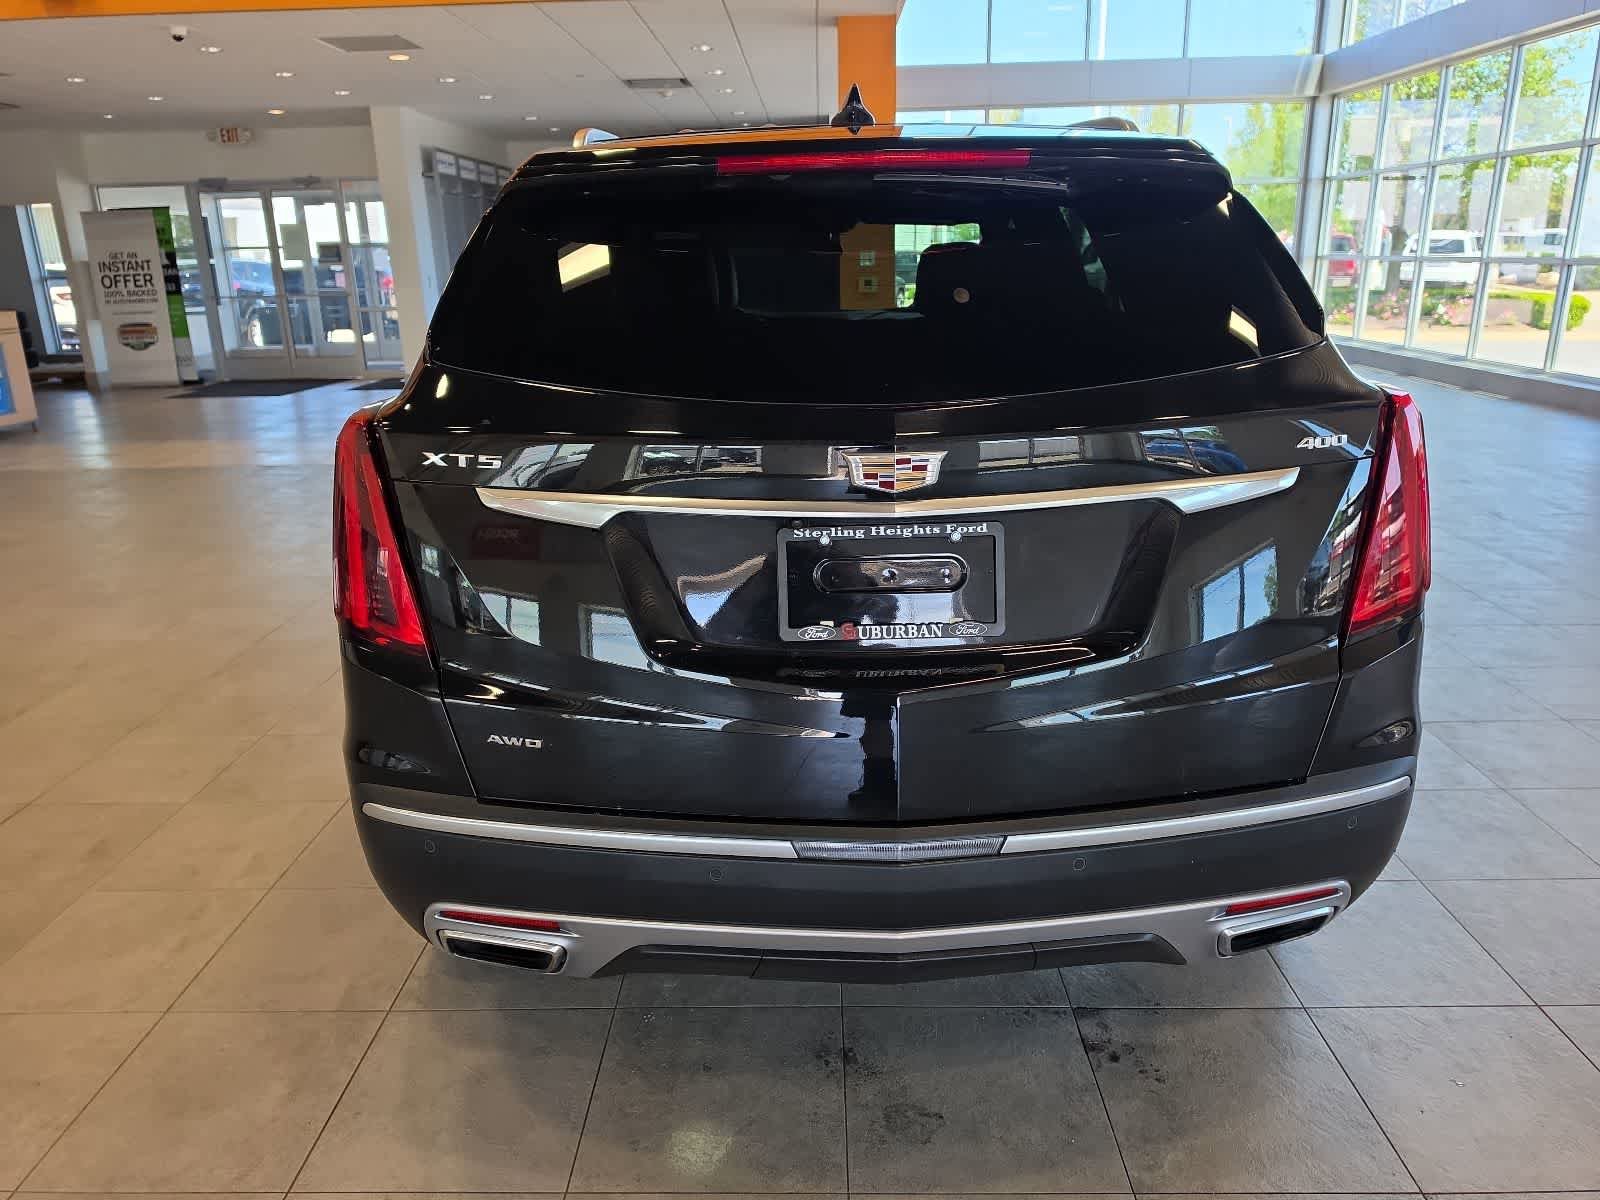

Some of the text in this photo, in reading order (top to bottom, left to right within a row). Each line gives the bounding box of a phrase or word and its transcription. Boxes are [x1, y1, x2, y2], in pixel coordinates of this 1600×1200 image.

[220, 128, 240, 143] EXIT
[108, 251, 138, 260] GET AN
[97, 259, 152, 273] INSTANT
[101, 273, 155, 289] OFFER
[126, 288, 158, 298] BACKED
[1296, 434, 1348, 450] 400
[421, 451, 502, 469] XT5
[793, 523, 988, 539] Sterling Heights Ford
[804, 626, 830, 639] Ford
[955, 624, 981, 637] Ford
[487, 734, 542, 749] AWD
